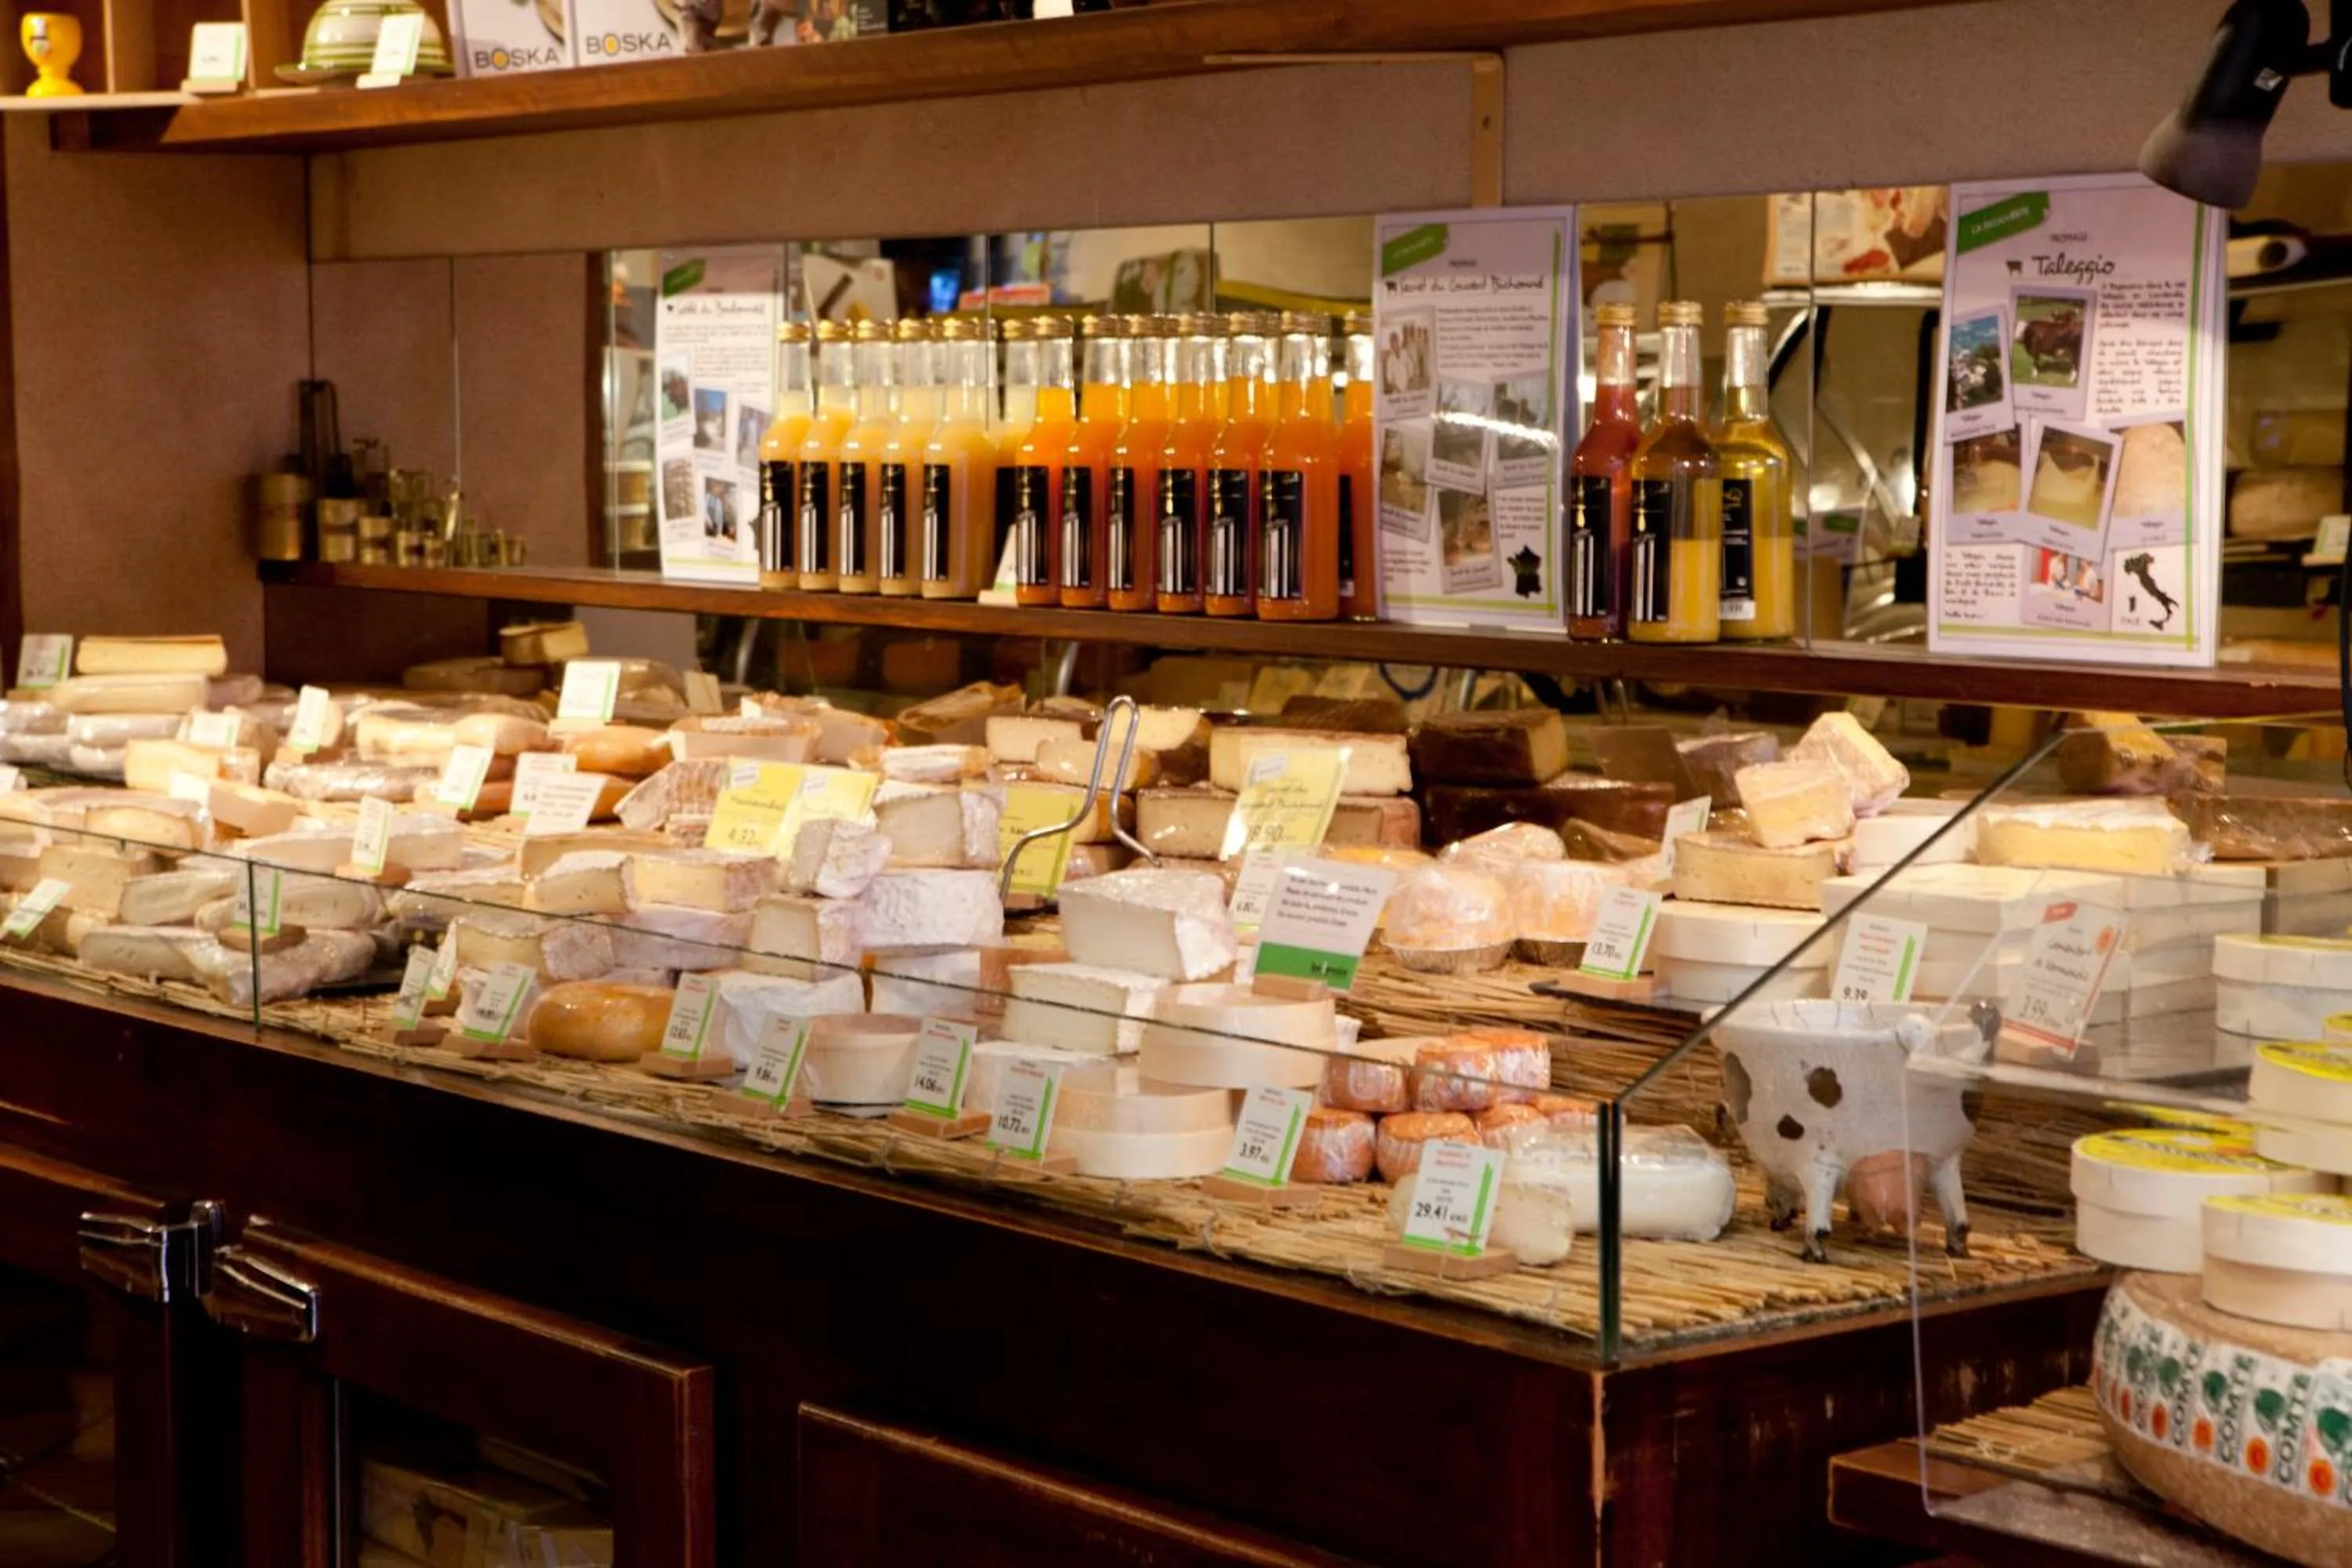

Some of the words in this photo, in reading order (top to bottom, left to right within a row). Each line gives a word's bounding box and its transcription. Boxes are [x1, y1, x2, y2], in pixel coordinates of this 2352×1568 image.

[586, 32, 673, 56] BOSKA
[474, 47, 559, 70] BOSKA
[2031, 252, 2115, 285] Taleggio
[1415, 1200, 1450, 1221] 29.41
